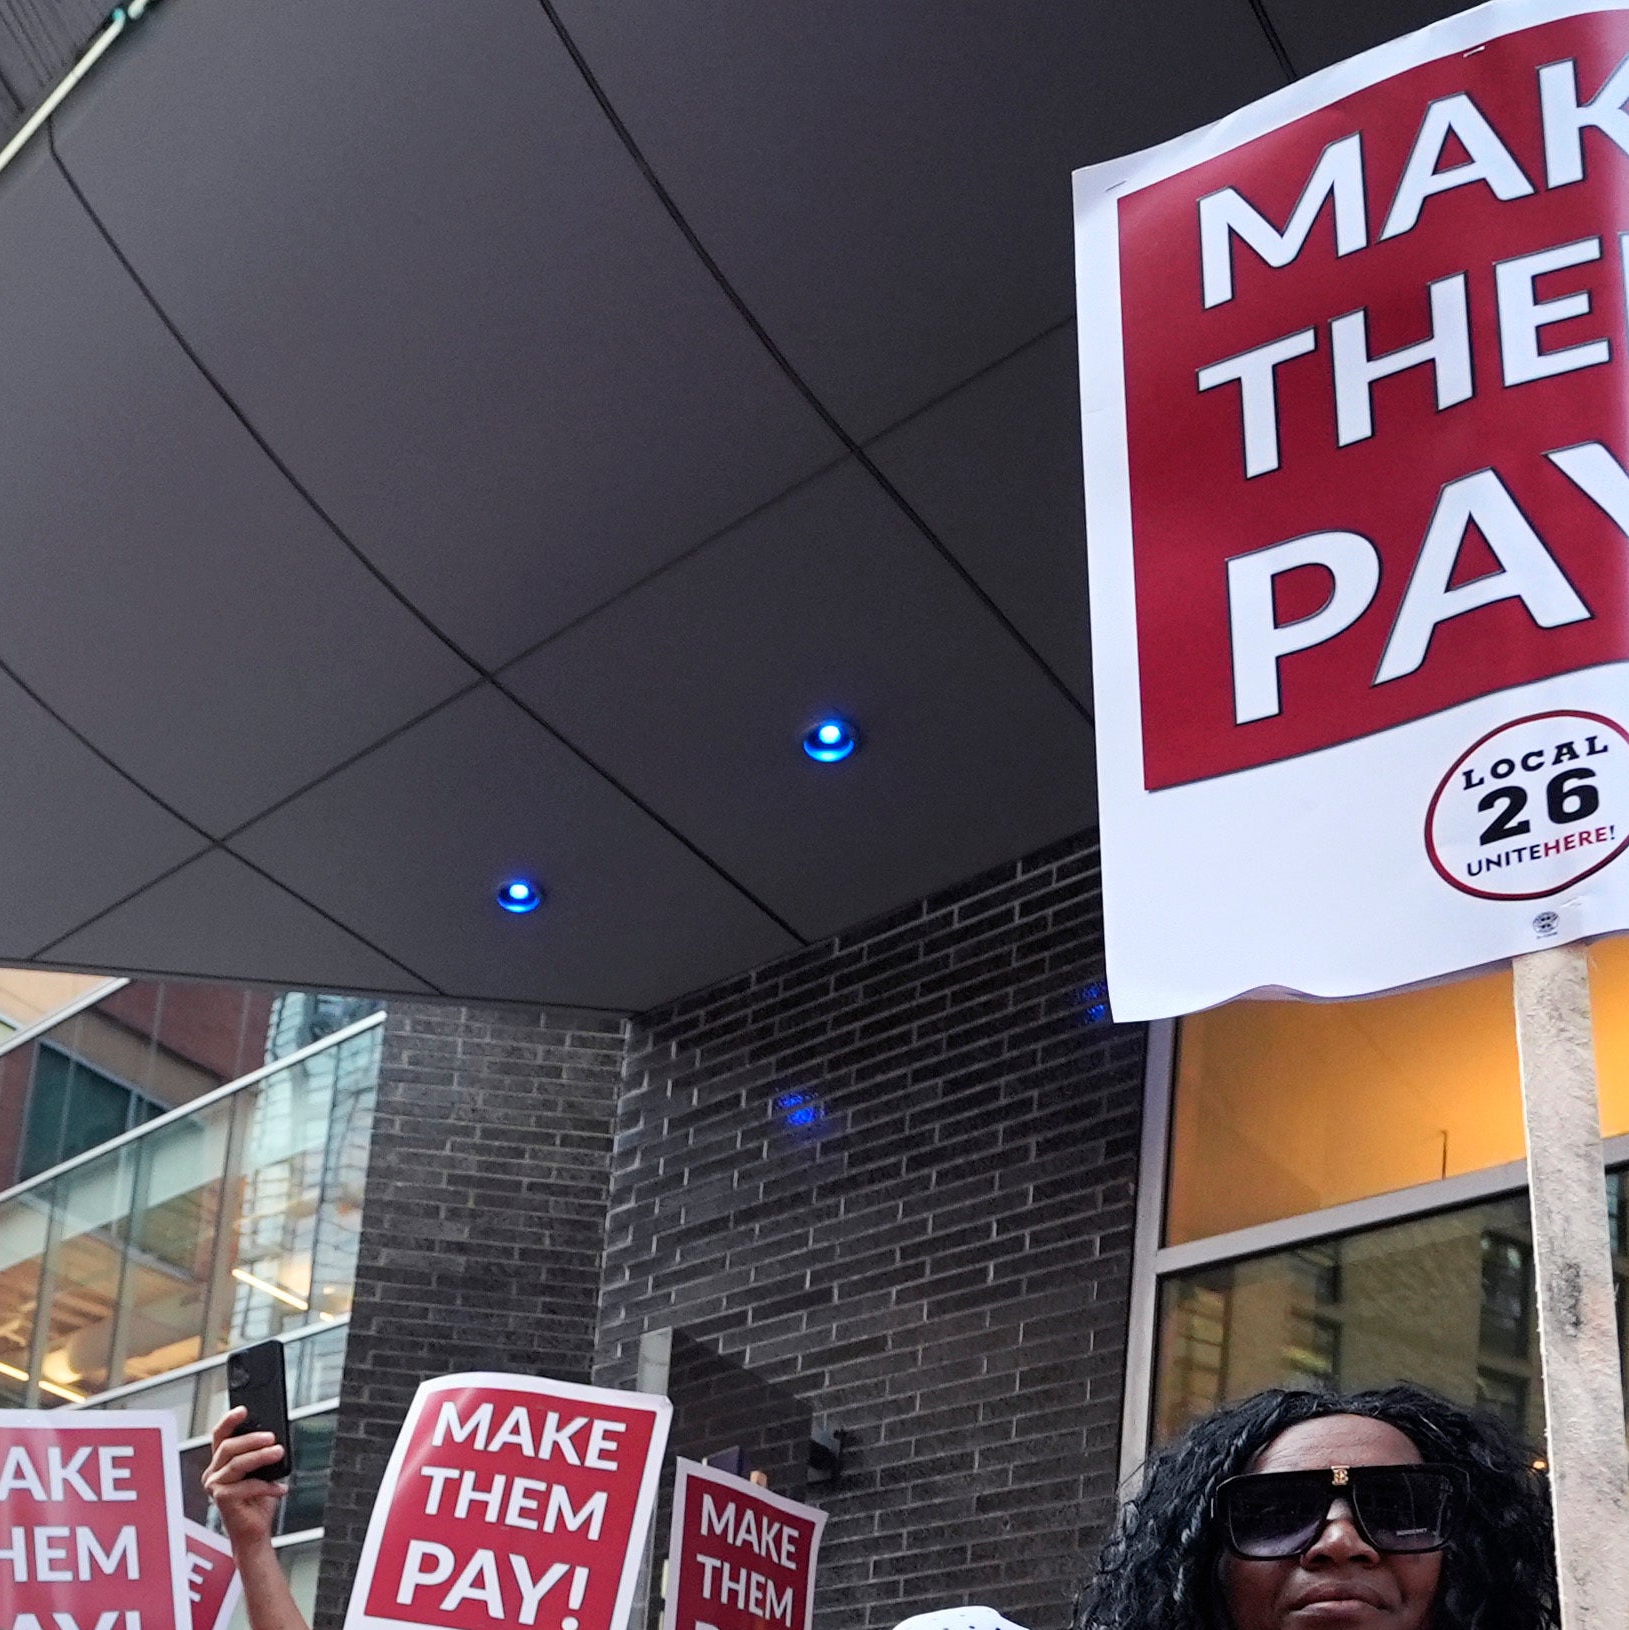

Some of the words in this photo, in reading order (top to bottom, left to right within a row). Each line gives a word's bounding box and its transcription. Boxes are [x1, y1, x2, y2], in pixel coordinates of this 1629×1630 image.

[1462, 735, 1609, 791] LOCAL
[1477, 767, 1600, 847] 26
[431, 1401, 627, 1472] MAKE
[420, 1466, 609, 1542] THEM
[700, 1493, 800, 1571] MAKE
[696, 1553, 794, 1628] THEM
